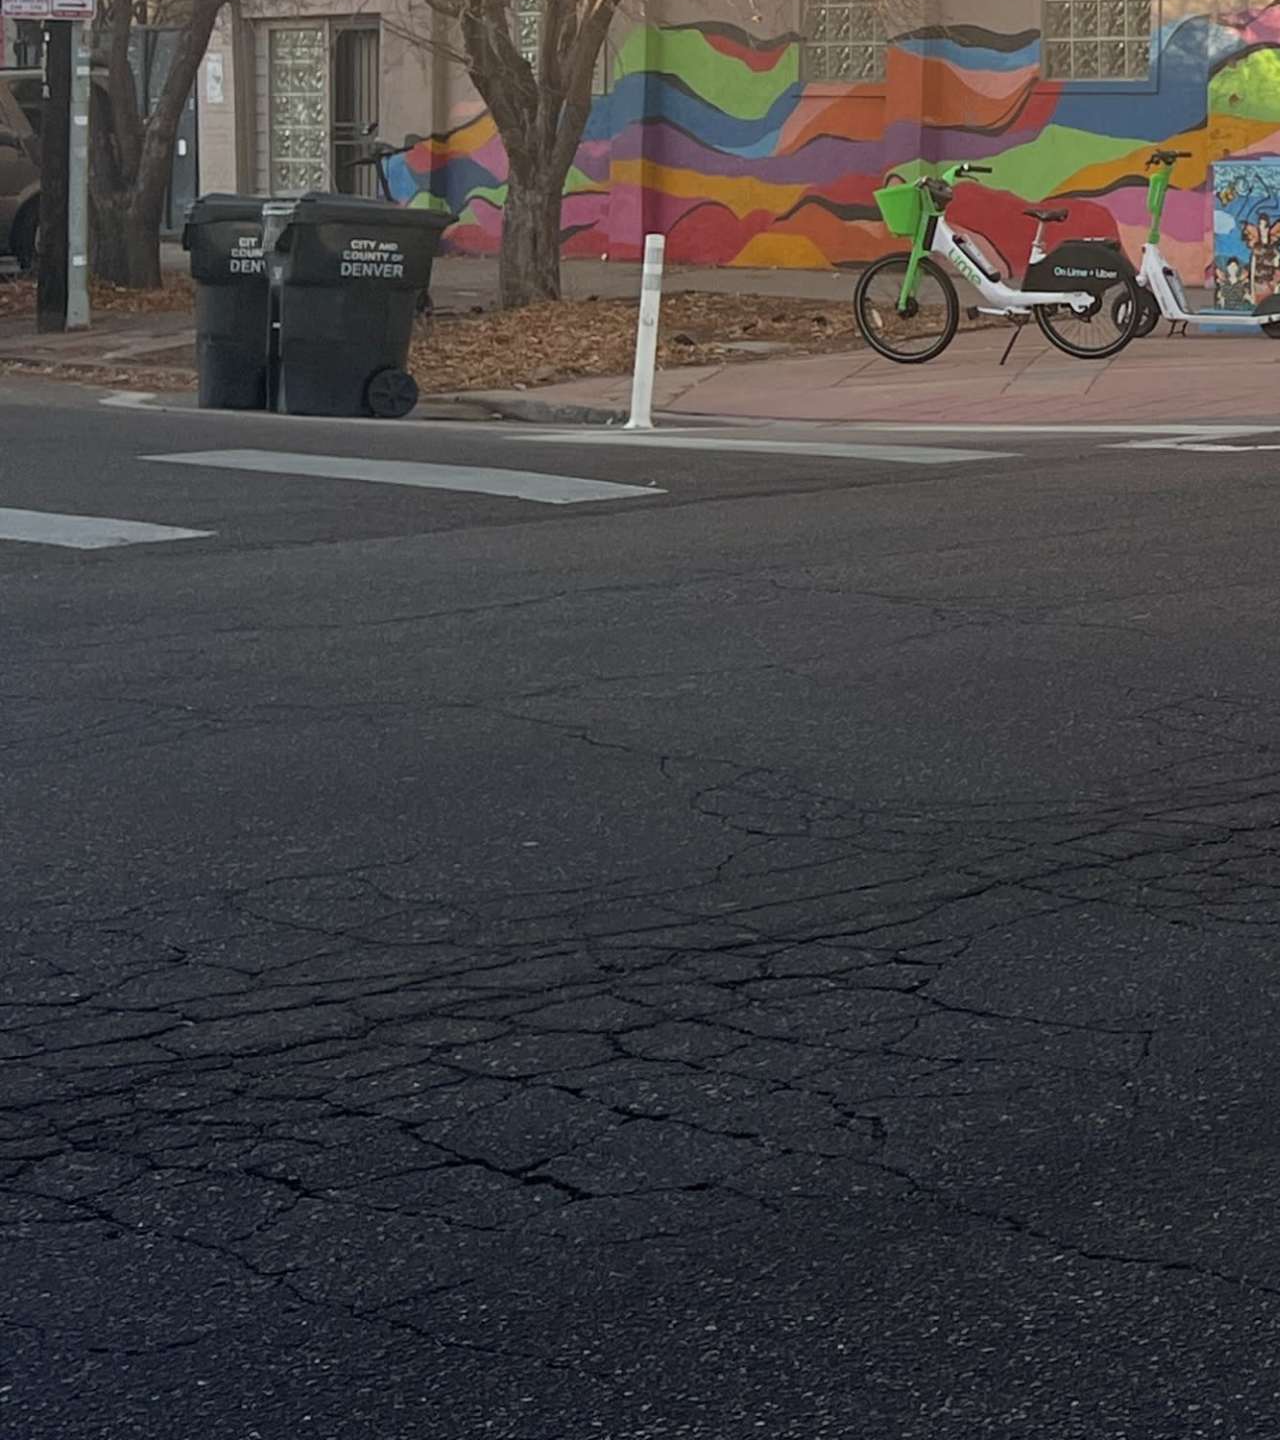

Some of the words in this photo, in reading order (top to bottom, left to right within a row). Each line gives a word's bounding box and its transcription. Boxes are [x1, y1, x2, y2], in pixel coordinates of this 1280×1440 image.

[238, 236, 259, 248] CIT
[350, 239, 377, 251] CITY
[378, 242, 399, 252] AND
[231, 248, 264, 258] COUN
[343, 250, 390, 261] COUNTY
[391, 253, 404, 262] OF
[229, 259, 265, 274] DEN
[340, 262, 404, 278] DENVER
[948, 248, 982, 287] Lime
[1053, 266, 1067, 277] On
[1067, 267, 1088, 278] Lime
[1095, 268, 1118, 279] Uber
